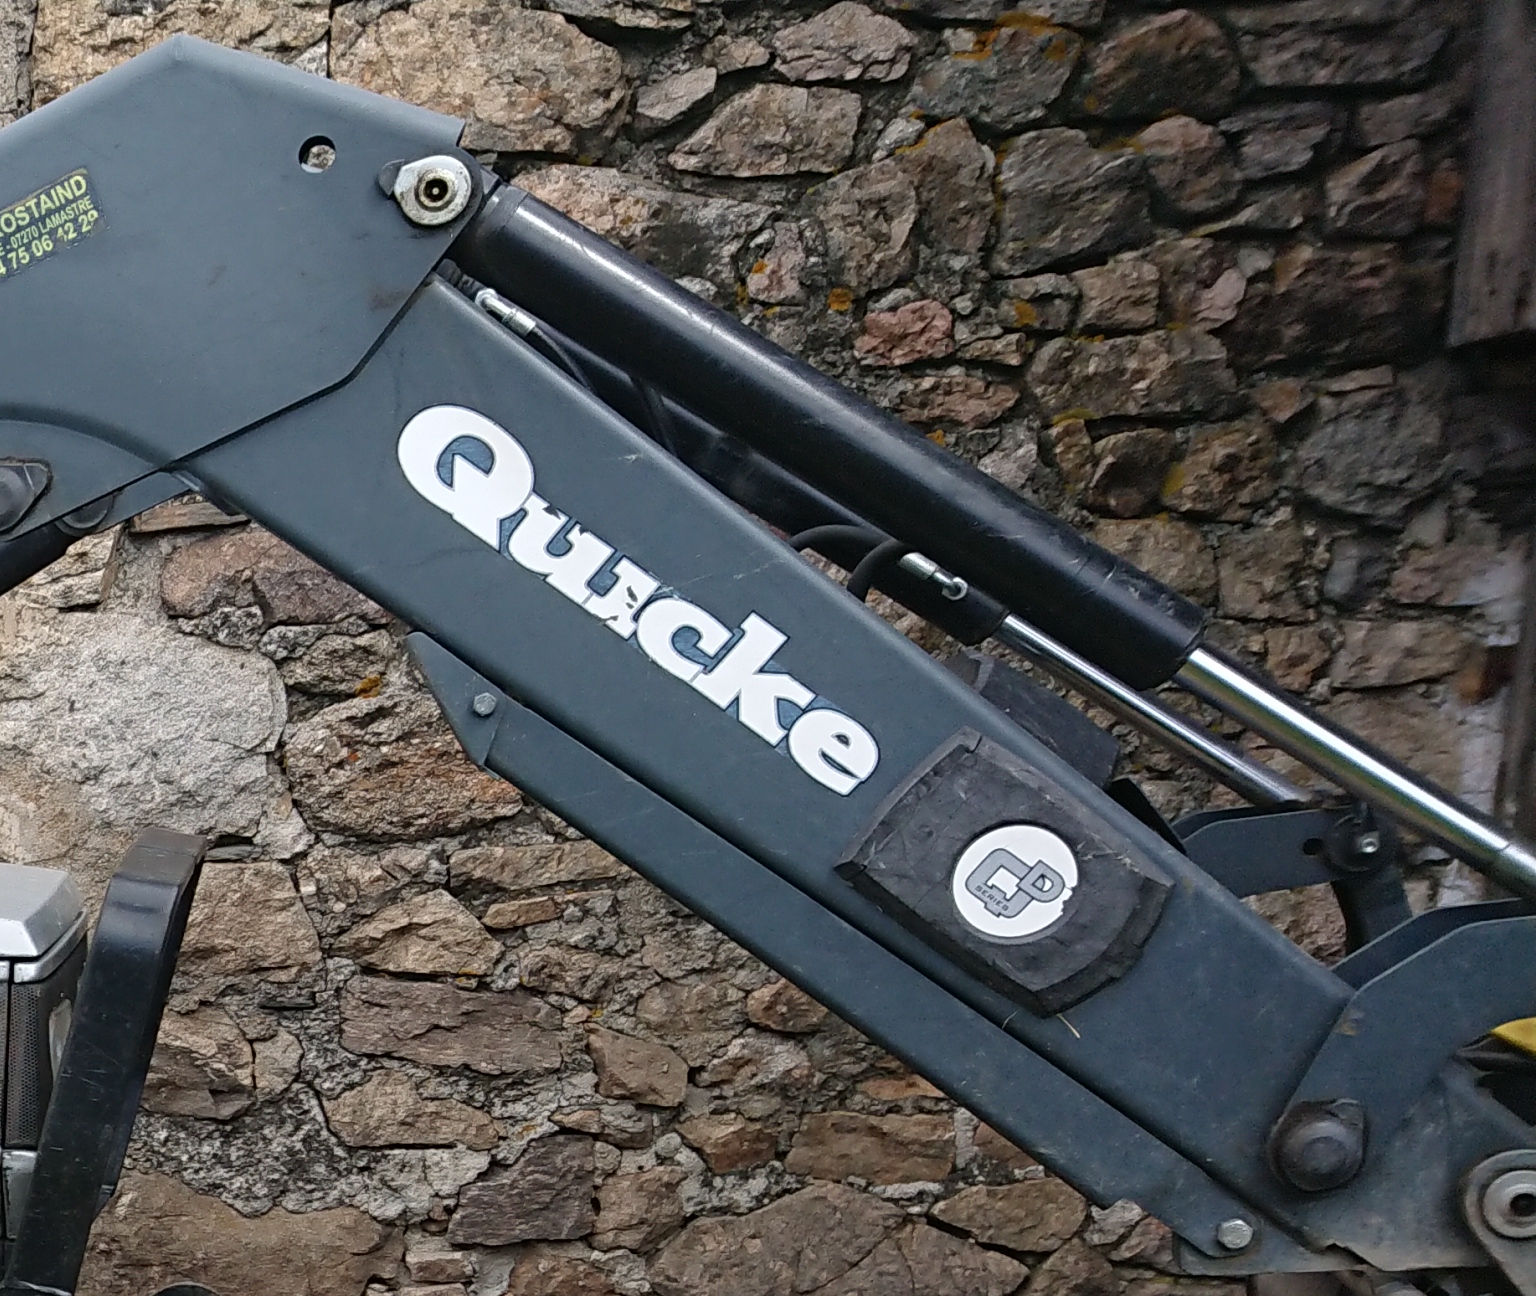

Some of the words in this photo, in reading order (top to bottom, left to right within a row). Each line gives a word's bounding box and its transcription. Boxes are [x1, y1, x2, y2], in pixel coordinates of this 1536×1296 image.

[10, 225, 39, 249] 07270
[38, 196, 93, 234] LAMASTRE
[7, 247, 30, 269] 75
[31, 235, 54, 257] 06
[397, 404, 880, 796] Quicke
[974, 884, 1010, 912] SERIES
